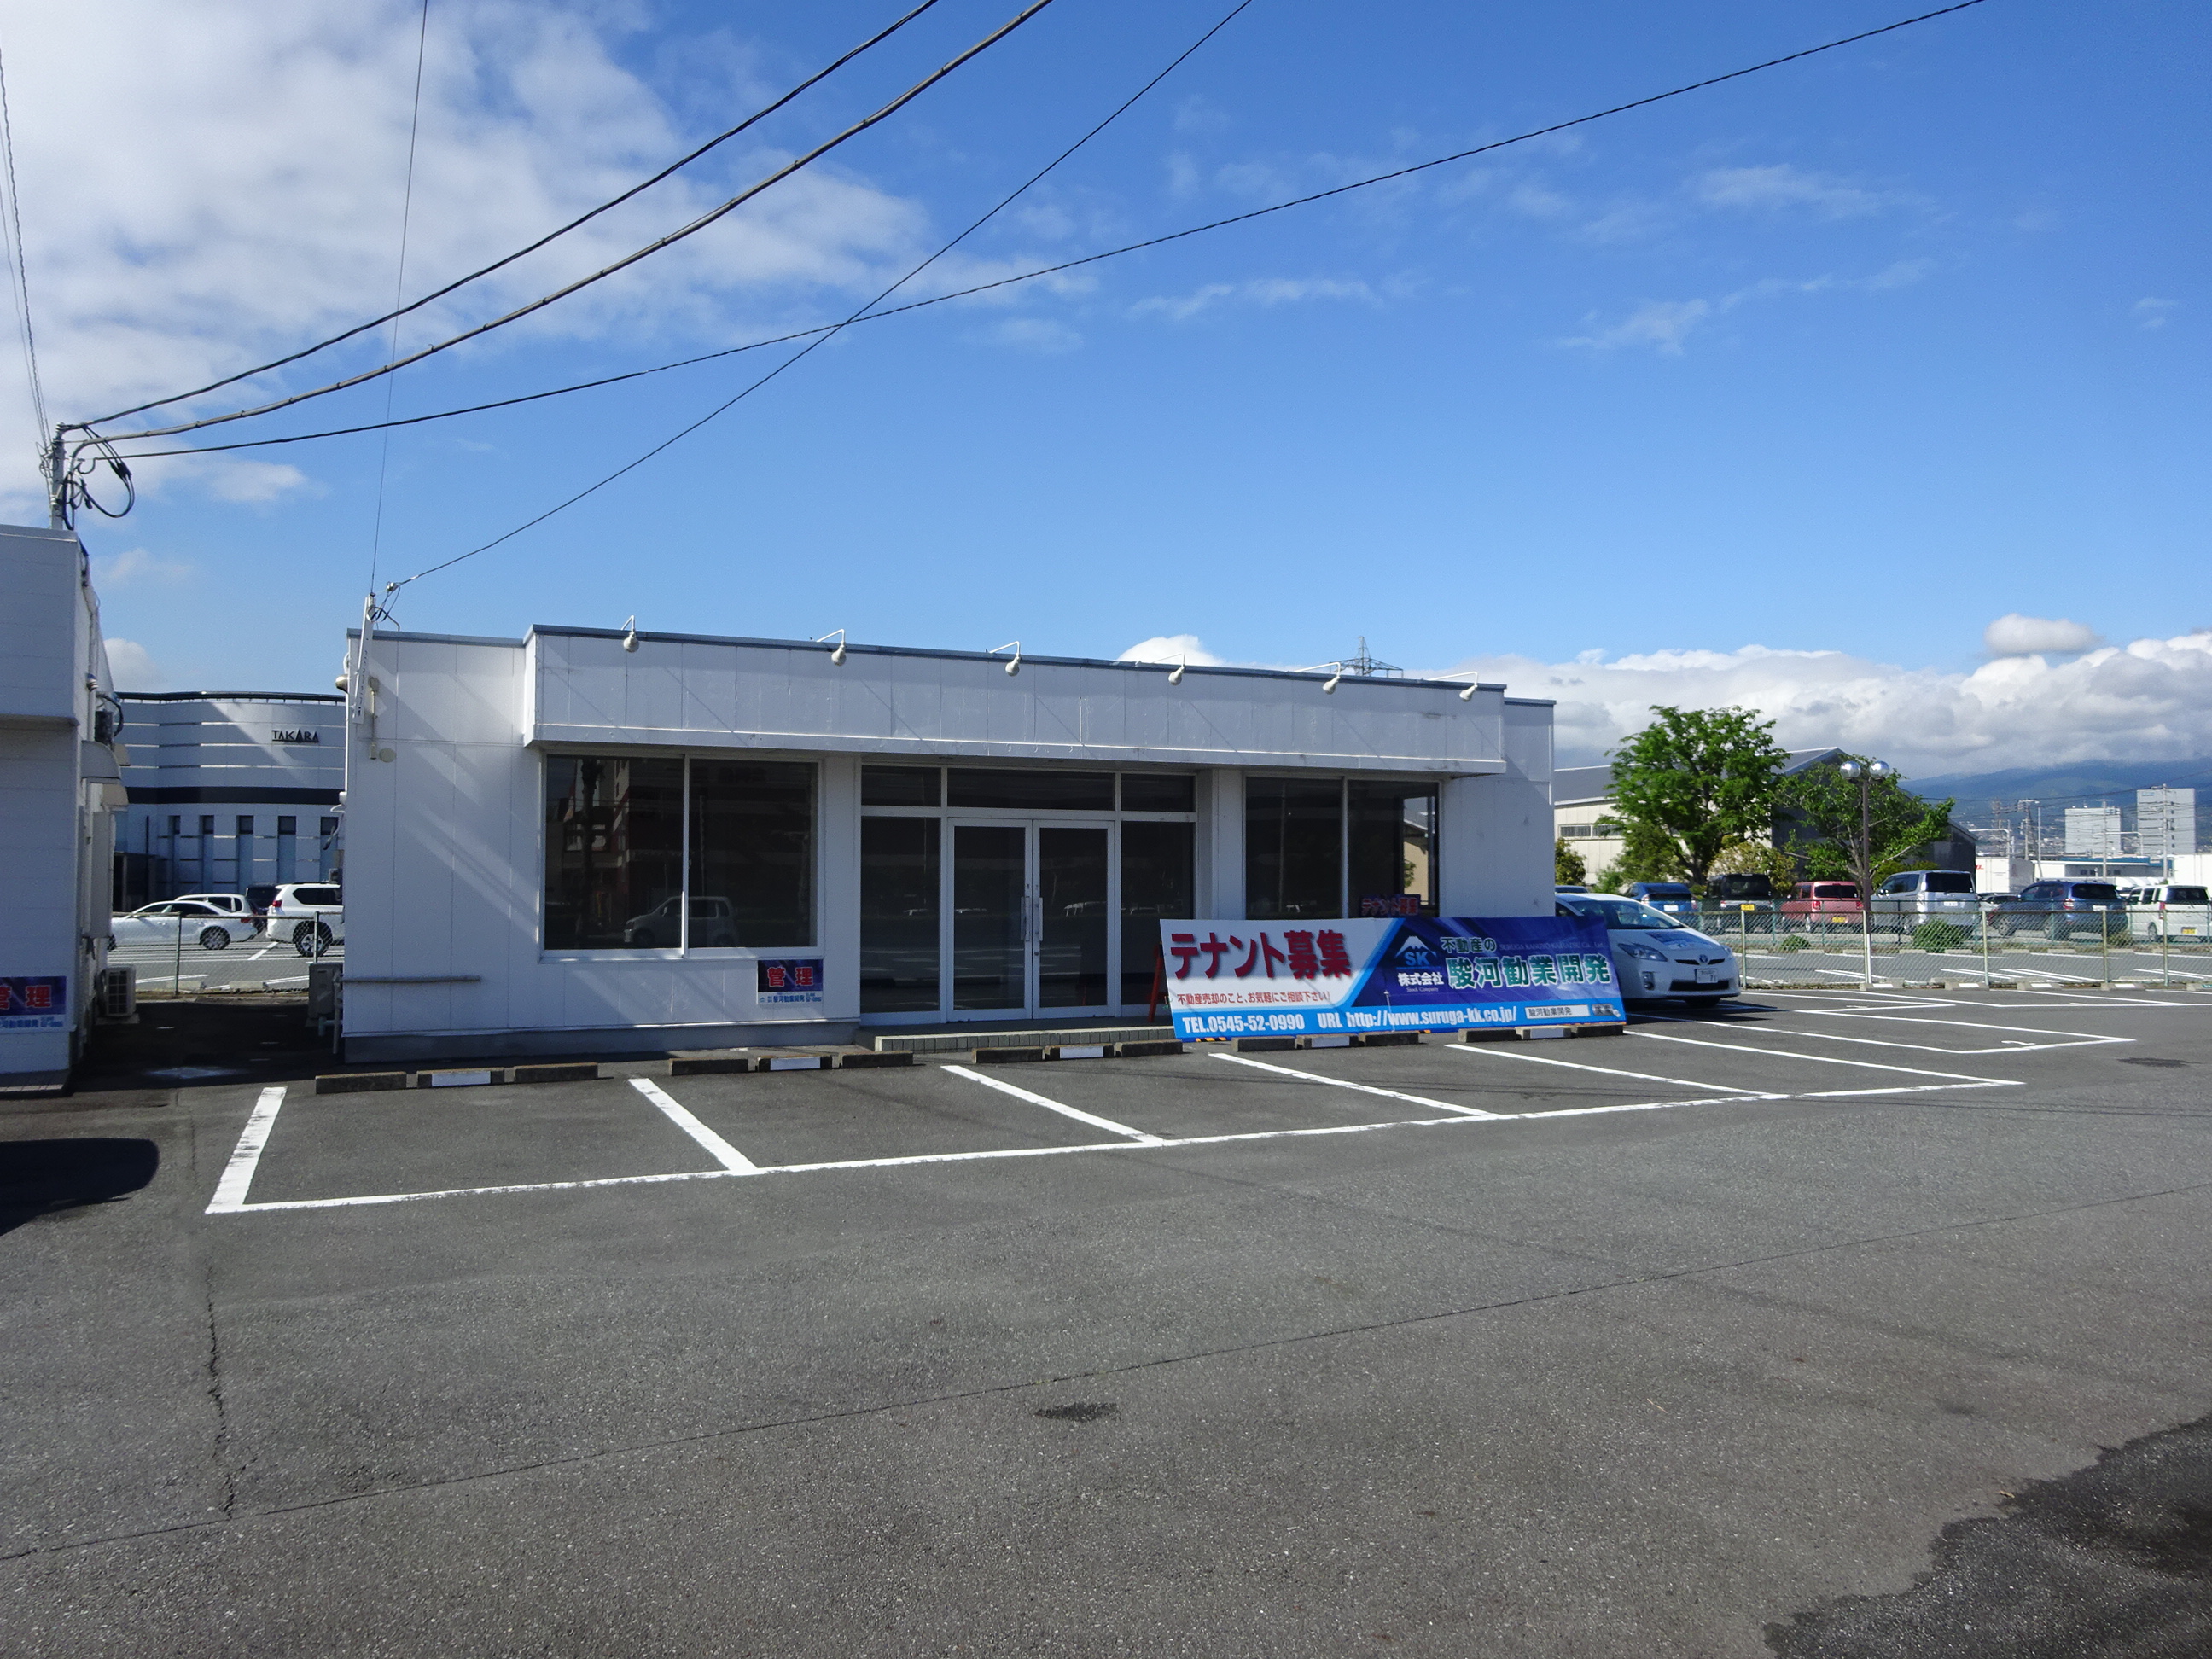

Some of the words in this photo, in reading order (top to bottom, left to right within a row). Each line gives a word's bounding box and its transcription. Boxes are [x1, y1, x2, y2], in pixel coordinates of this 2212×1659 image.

[272, 728, 319, 742] TAKARA
[1440, 936, 1496, 953] 不動産の
[1170, 929, 1351, 980] テナント募集
[1405, 951, 1429, 966] SK
[766, 966, 813, 987] 管理
[1397, 971, 1444, 987] 株式会社
[1445, 953, 1611, 990] 駿河勧業開発
[1182, 1014, 1306, 1033] TEL.0545-52-0990
[1317, 1012, 1342, 1029] URL
[1346, 1005, 1517, 1028] http://www.suruga-kk.co.jp/
